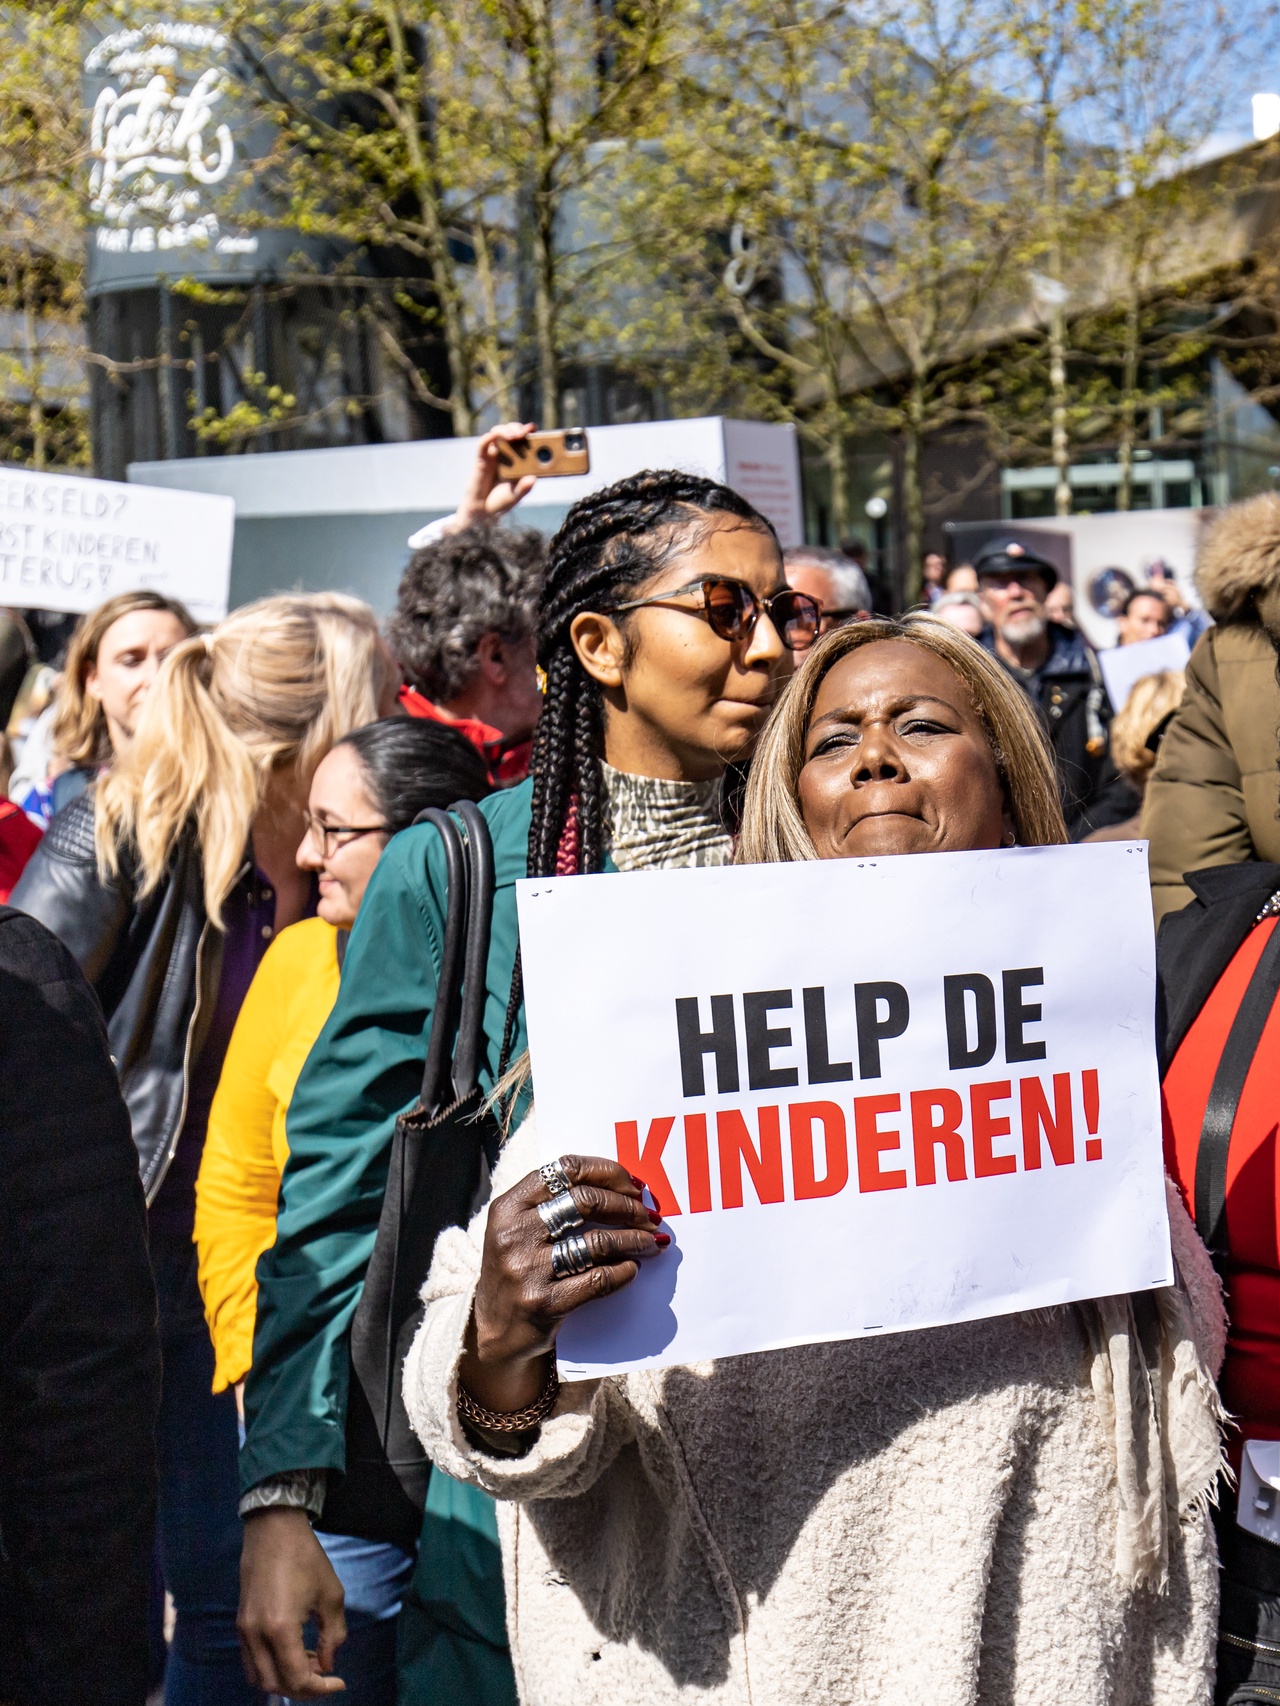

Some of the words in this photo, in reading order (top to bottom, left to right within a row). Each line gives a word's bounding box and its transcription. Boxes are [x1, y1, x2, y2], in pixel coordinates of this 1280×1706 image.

[43, 525, 161, 564] KINDEREN
[675, 980, 910, 1098] HELP
[943, 966, 1047, 1071] DE
[614, 1068, 1103, 1218] KINDEREN!
